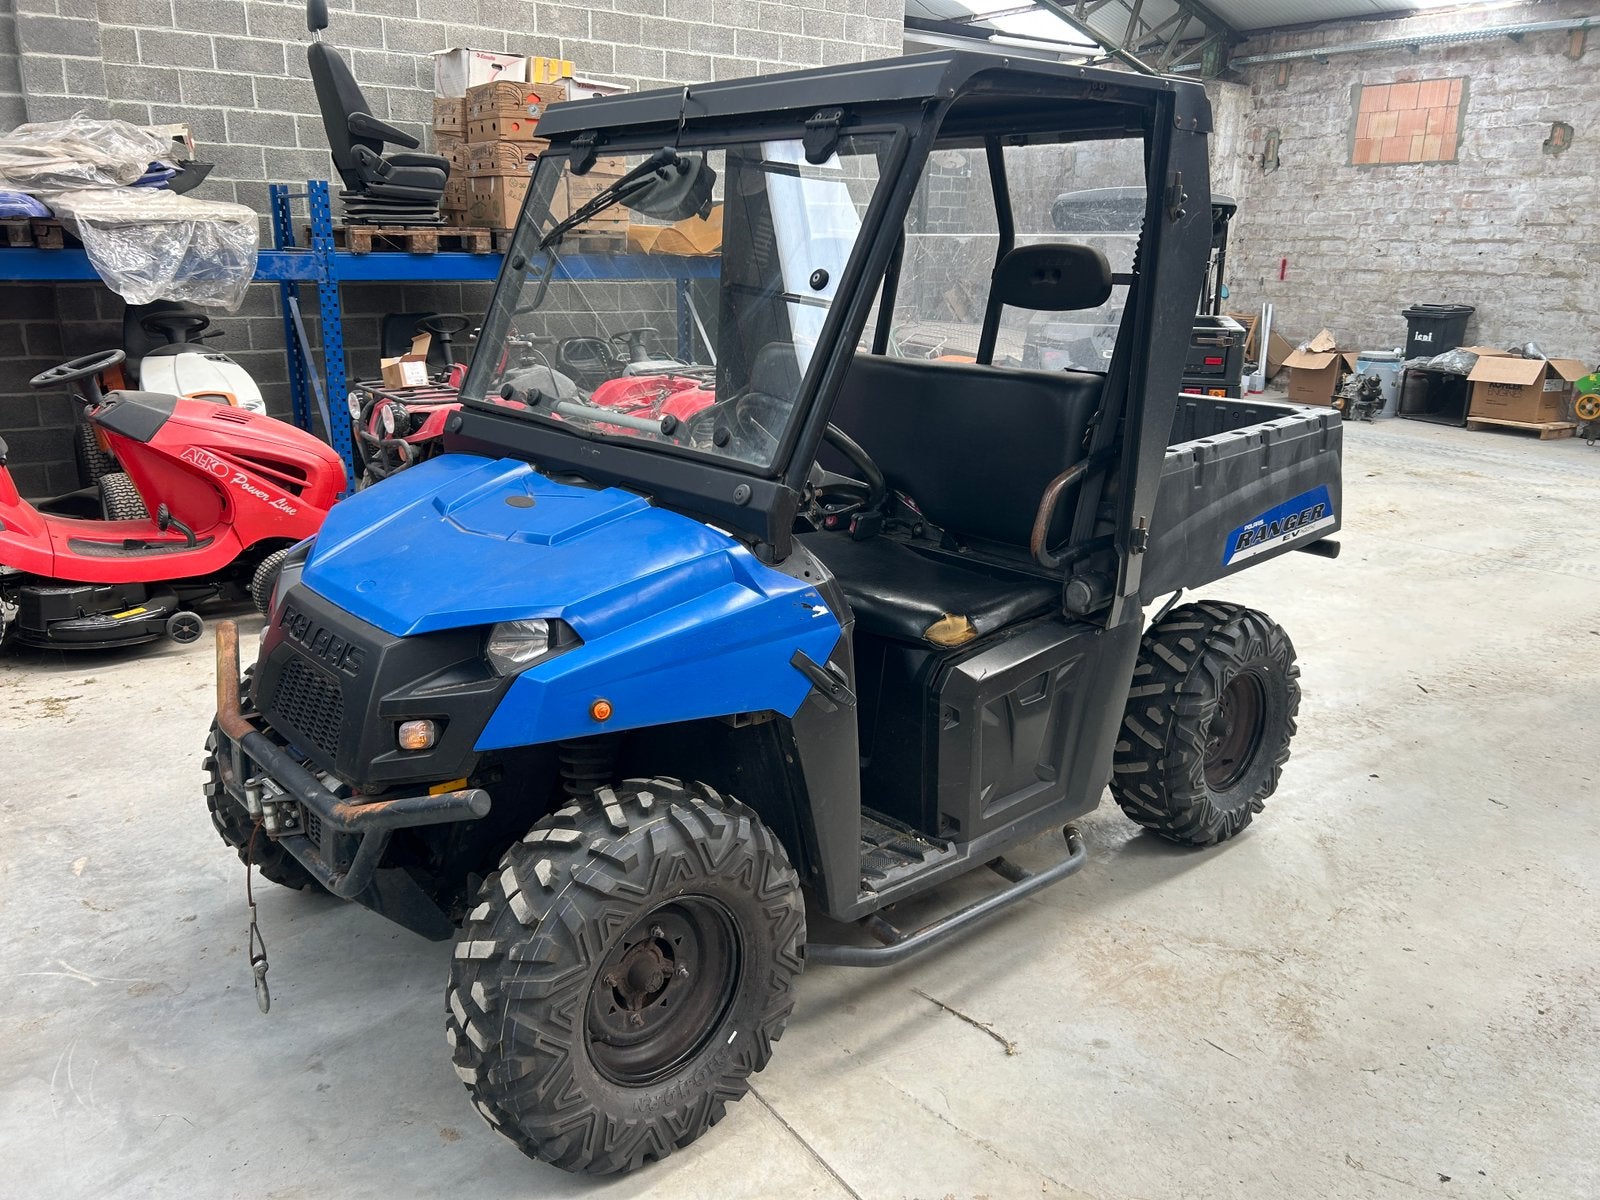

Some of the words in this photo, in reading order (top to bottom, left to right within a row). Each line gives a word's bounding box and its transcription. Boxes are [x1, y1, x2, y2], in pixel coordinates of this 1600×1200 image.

[230, 472, 269, 501] Power
[268, 498, 297, 516] Line
[1234, 502, 1326, 552] RANGER
[1282, 529, 1300, 542] EV
[279, 604, 368, 678] POLARIS
